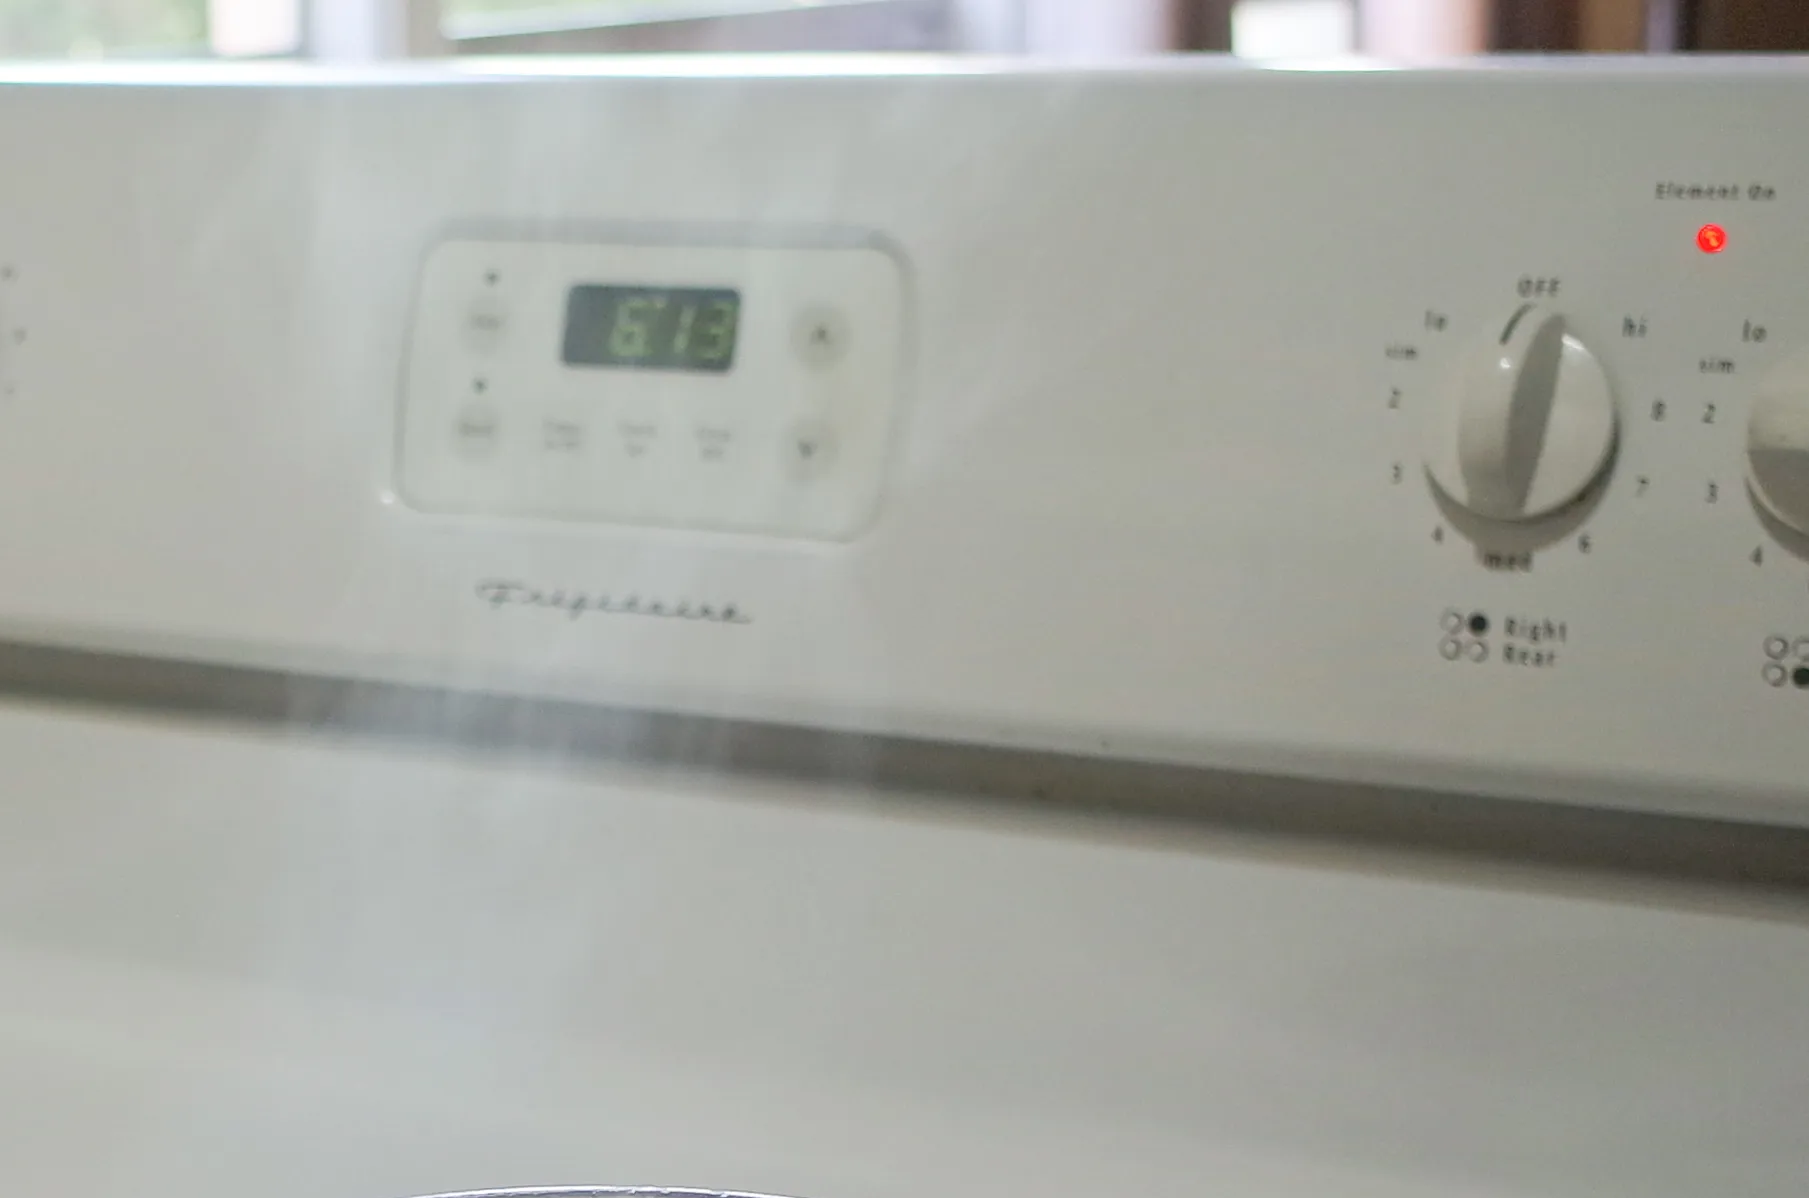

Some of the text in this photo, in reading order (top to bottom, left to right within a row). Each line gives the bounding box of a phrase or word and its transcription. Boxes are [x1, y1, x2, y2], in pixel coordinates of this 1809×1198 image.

[1655, 181, 1777, 200] Element On
[1517, 275, 1561, 298] OFF
[1424, 309, 1448, 332] lo
[1622, 316, 1647, 338] hi
[1742, 318, 1767, 343] lo
[1385, 344, 1419, 361] sim
[1698, 357, 1735, 374] sim
[1388, 386, 1401, 410] 2
[1701, 402, 1716, 424] 2
[1636, 474, 1650, 497] 7
[1705, 481, 1719, 504] 3
[1748, 545, 1764, 567] 4
[1504, 616, 1567, 644] Right
[1502, 643, 1555, 668] Rear
